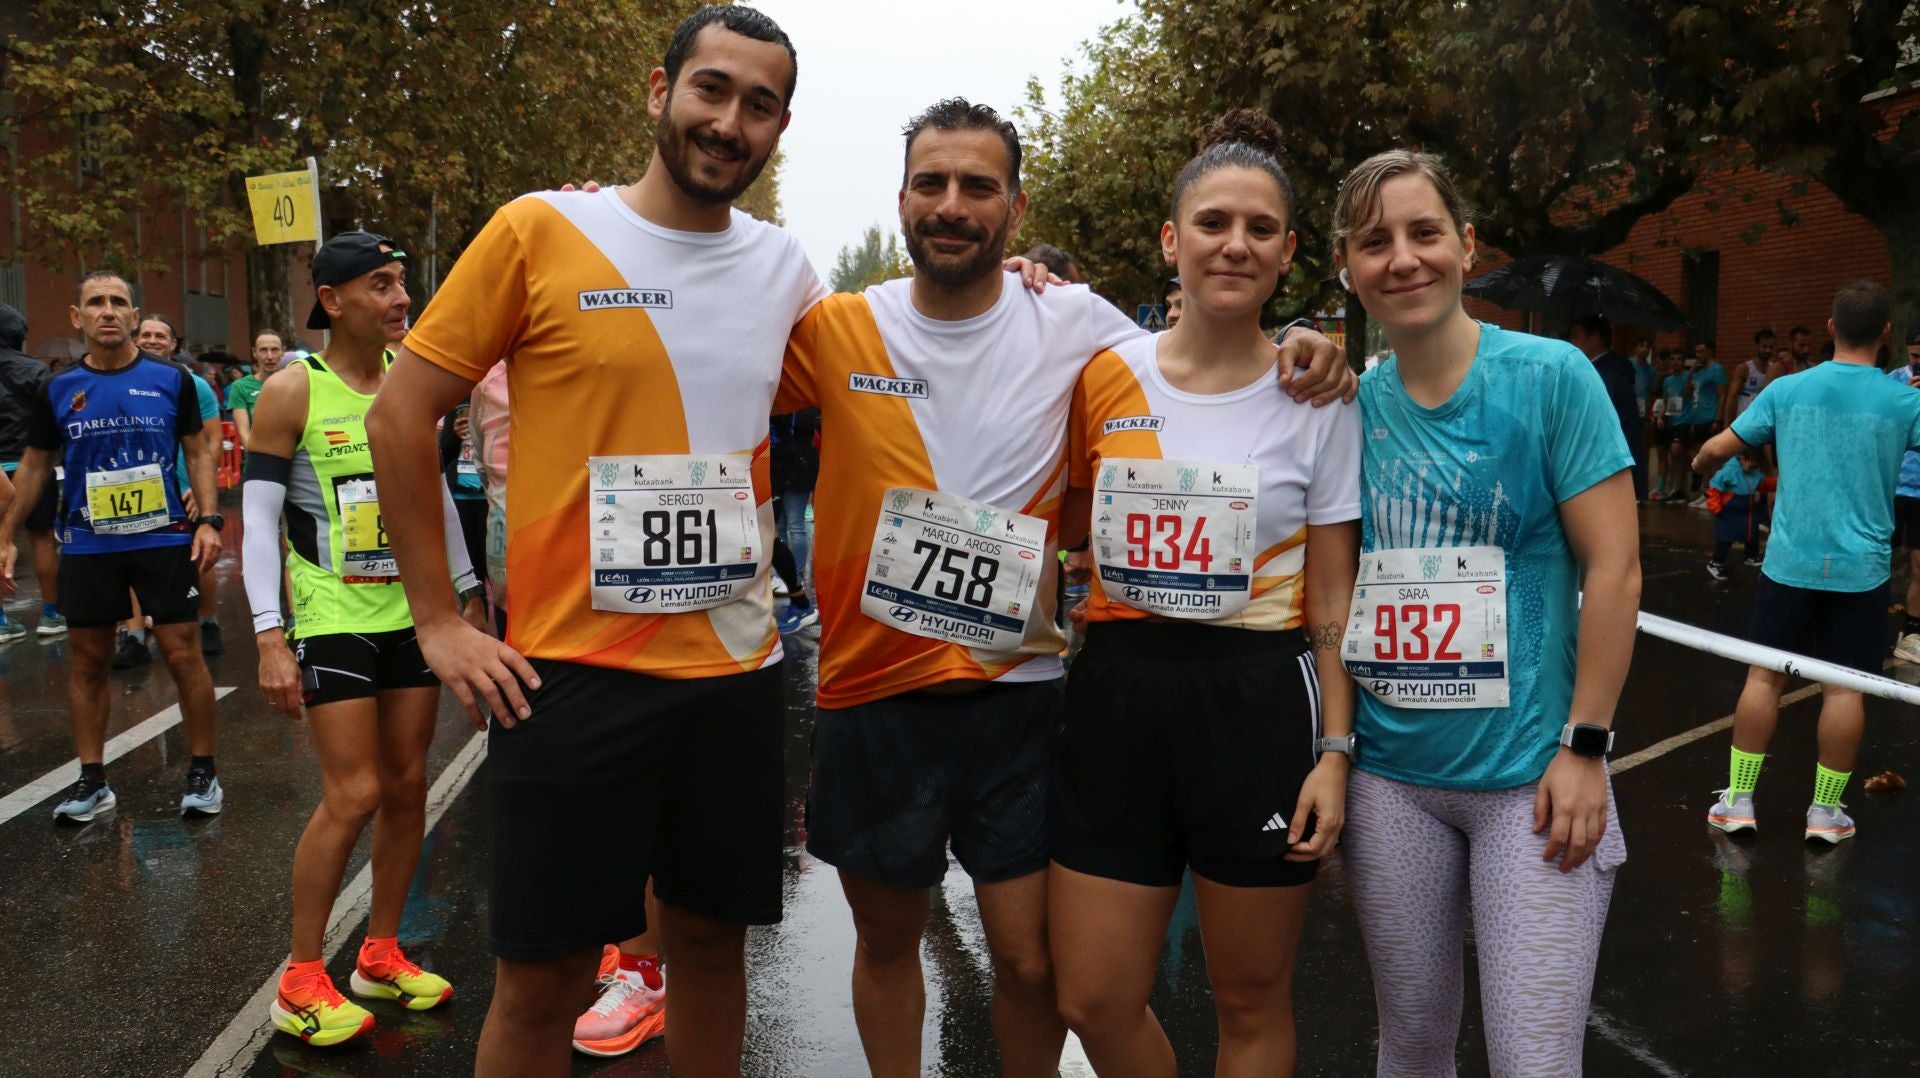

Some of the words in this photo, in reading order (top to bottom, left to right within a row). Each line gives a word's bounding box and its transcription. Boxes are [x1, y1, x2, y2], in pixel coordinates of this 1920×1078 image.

[273, 194, 295, 228] 40
[582, 292, 667, 306] WACKER
[852, 376, 925, 395] WACKER
[83, 416, 165, 430] AREACLINICA
[322, 413, 361, 425] macron
[1105, 418, 1160, 432] WACKER
[325, 442, 370, 458] SYDNE
[634, 464, 644, 478] k
[719, 463, 727, 477] k
[1127, 467, 1136, 481] k
[634, 478, 674, 486] kutxabank
[1213, 471, 1222, 484] k
[365, 486, 372, 494] k
[1127, 481, 1163, 490] kutxabank
[1212, 485, 1251, 494] kutxabank
[110, 489, 143, 517] 147
[658, 493, 704, 506] SERGIO
[924, 497, 934, 511] k
[1152, 498, 1189, 511] JENNY
[922, 510, 959, 526] kutxabank
[1006, 519, 1015, 533] k
[642, 509, 718, 567] 861
[922, 526, 960, 545] MARIO
[964, 537, 1002, 556] ARCOS
[1005, 533, 1039, 547] kutxabank
[1126, 513, 1213, 573] 934
[1377, 559, 1383, 572] k
[1457, 556, 1467, 569] k
[910, 538, 1000, 609] 758
[1457, 570, 1498, 578] kutxabank
[660, 584, 733, 601] HYUNDAI
[1147, 591, 1221, 607] HYUNDAI
[1398, 588, 1430, 600] SARA
[660, 600, 692, 608] Lemauto
[692, 596, 730, 606] Automoción
[1175, 605, 1220, 614] Automoción
[920, 614, 995, 641] HYUNDAI
[1374, 603, 1462, 661] 932
[919, 625, 949, 637] Lemauto
[950, 632, 992, 646] Automoción
[1397, 683, 1476, 696] HYUNDAI
